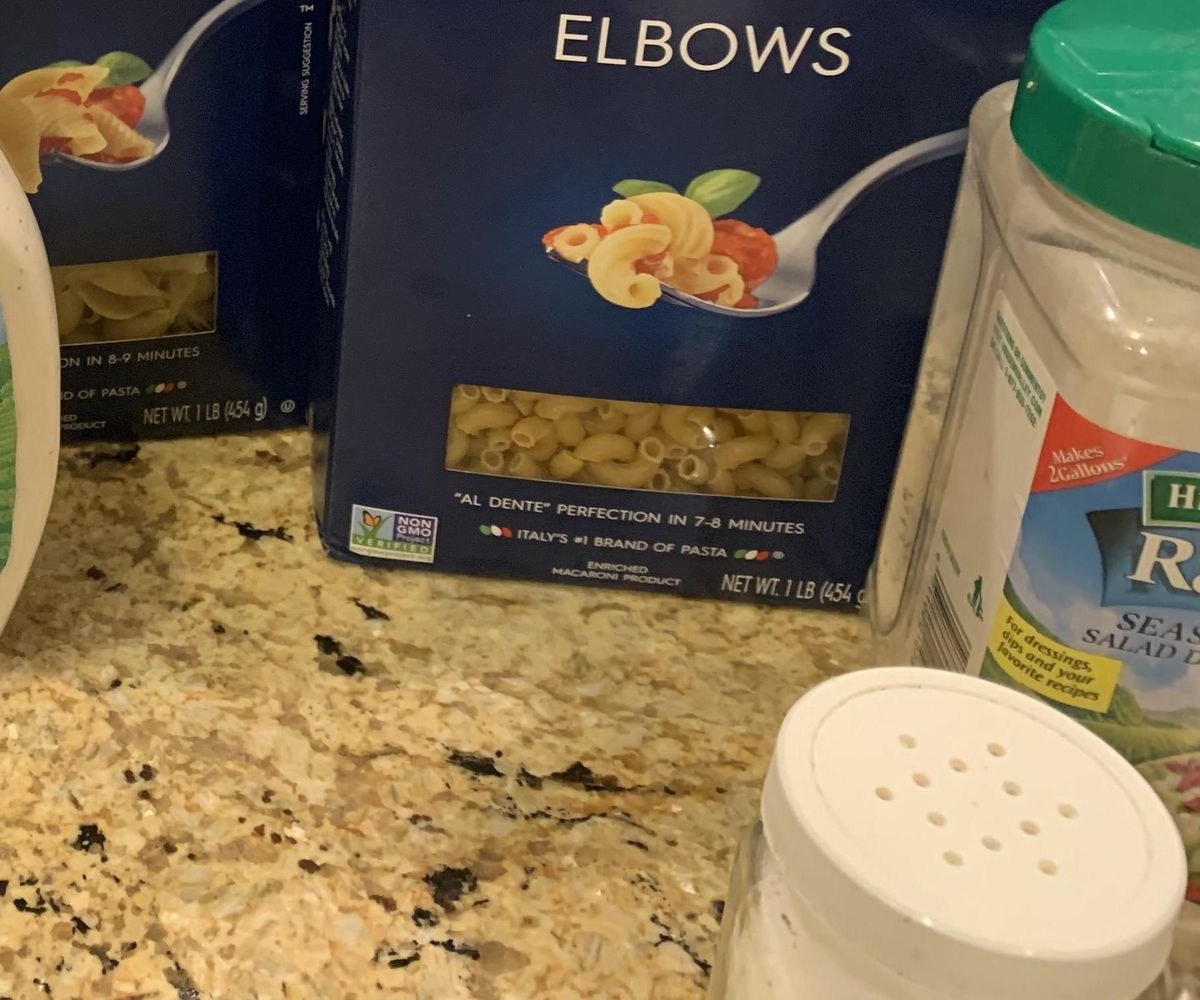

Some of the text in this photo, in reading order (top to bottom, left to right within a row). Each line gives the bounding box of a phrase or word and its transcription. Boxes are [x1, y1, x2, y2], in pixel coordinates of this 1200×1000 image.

[554, 13, 852, 76] ELBOWS
[299, 22, 313, 116] SERVING SUGGESTION
[87, 355, 102, 367] IN
[108, 353, 132, 365] 8-9
[137, 346, 201, 362] MINUTES
[78, 388, 97, 400] OF
[101, 386, 141, 398] PASTA
[143, 406, 169, 425] NET
[205, 402, 221, 421] LB
[224, 399, 250, 422] (454
[1052, 446, 1105, 466] Makes
[397, 525, 432, 537] GMO
[398, 516, 432, 528] NON
[557, 504, 661, 524] PERFECTION
[669, 513, 688, 526] IN
[694, 516, 722, 528] 7-8
[728, 518, 805, 535] MINUTES
[356, 536, 429, 553] VERIFIED
[517, 529, 568, 544] ITALY'S
[594, 536, 648, 551] BRAND
[653, 540, 675, 553] OF
[680, 544, 728, 558] PASTA
[552, 567, 681, 587] MACARONI PRODUCT
[587, 561, 648, 574] ENRICHED
[721, 574, 753, 593] NET
[755, 576, 780, 596] WT.
[785, 579, 792, 597] 1
[796, 581, 816, 600] LB
[820, 581, 852, 604] (454
[1006, 615, 1092, 672] For dressings,
[1117, 612, 1200, 646] SEAS
[1002, 630, 1096, 685] dips and your
[1081, 628, 1177, 660] SALAD
[996, 641, 1100, 701] favorite recipes
